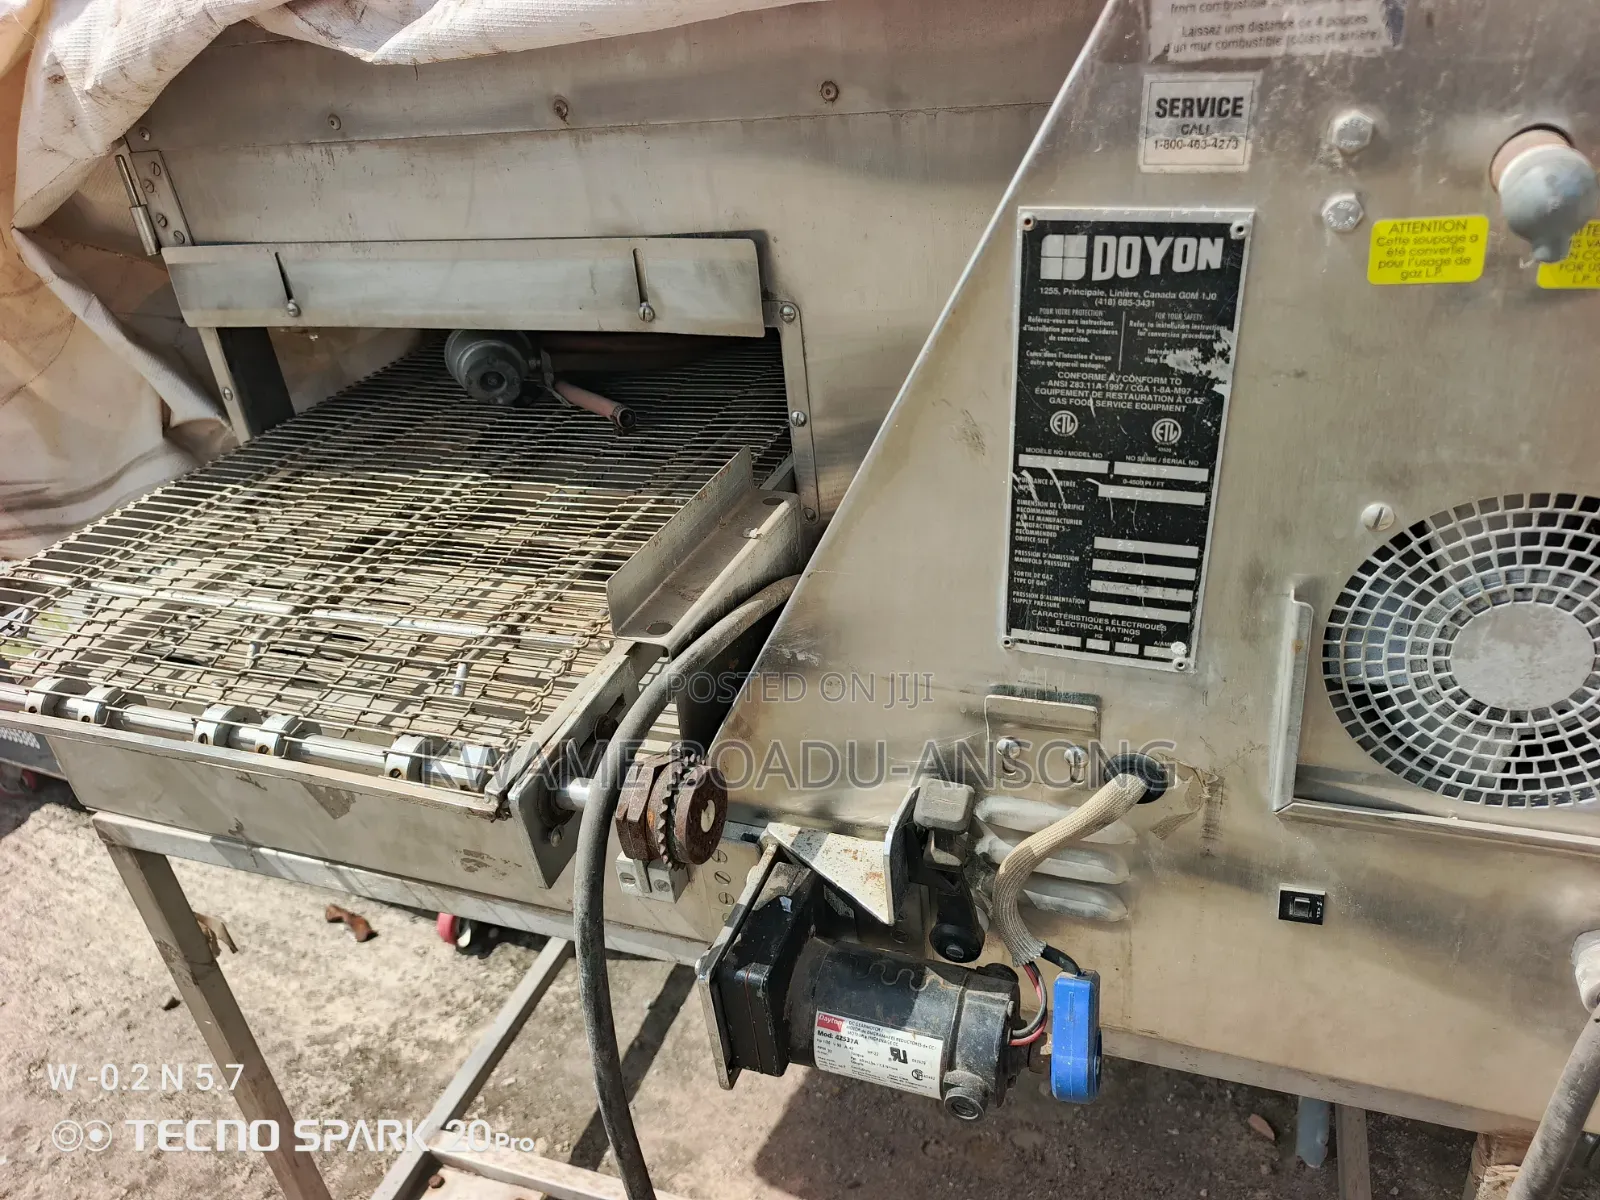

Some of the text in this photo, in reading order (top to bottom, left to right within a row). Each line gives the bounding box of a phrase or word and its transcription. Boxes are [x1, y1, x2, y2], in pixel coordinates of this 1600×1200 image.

[1155, 96, 1244, 118] SERVICE
[1388, 219, 1467, 236] ATTENTION
[1376, 235, 1410, 247] Cette
[1386, 246, 1405, 257] été
[1092, 235, 1224, 281] DOYON
[1377, 255, 1471, 272] pour l'usage de
[1400, 269, 1422, 282] gaz
[1143, 290, 1177, 299] Canada
[1094, 298, 1116, 307] (418)
[1039, 307, 1104, 317] POUR VOTRE PROTECTION
[1155, 312, 1202, 321] FOR YOUR SAFETY
[1080, 318, 1114, 327] instructions
[1129, 320, 1146, 328] Refer
[1155, 321, 1191, 330] installation
[1023, 324, 1060, 333] d'installation
[1061, 327, 1075, 335] pour
[1058, 371, 1107, 382] CONFORME
[1123, 375, 1168, 385] CONFORM
[1169, 377, 1182, 386] TO
[1047, 379, 1068, 388] ANSI
[1130, 384, 1150, 393] CGA
[1034, 386, 1090, 399] ÉQUIPEMENT
[1091, 390, 1104, 398] DE
[1105, 391, 1174, 403] RESTAURATION
[1184, 396, 1205, 405] GAZ
[1049, 396, 1188, 413] GAS FOOD SERVICE EQUIPMENT
[1068, 450, 1091, 458] MODEL
[1125, 454, 1136, 462] NO
[1162, 457, 1187, 465] SERIAL
[1155, 480, 1165, 488] FT
[1016, 499, 1048, 508] DIMENSION
[1058, 502, 1085, 511] L'ORIFICE
[1028, 514, 1035, 522] LE
[1036, 515, 1083, 525] MANUFACTURIER
[1015, 528, 1057, 538] RECOMMENDED
[1014, 535, 1049, 545] ORIFICE SIZE
[1014, 549, 1080, 561] PRESSION D'ADMISSION
[1013, 556, 1071, 568] MANIFOLD PRESSURE
[1013, 570, 1032, 578] SORTIE
[1013, 577, 1026, 585] TYPE
[1012, 590, 1086, 605] PRESSION D'ALIMENTATION
[1012, 597, 1060, 609] SUPPLY PRESSURE
[1031, 609, 1110, 625] CARACTÉRISTIQUES
[1055, 619, 1141, 636] ELECTRICAL RATINGS
[818, 1013, 844, 1026] Dayton
[817, 1030, 834, 1039] Mod:
